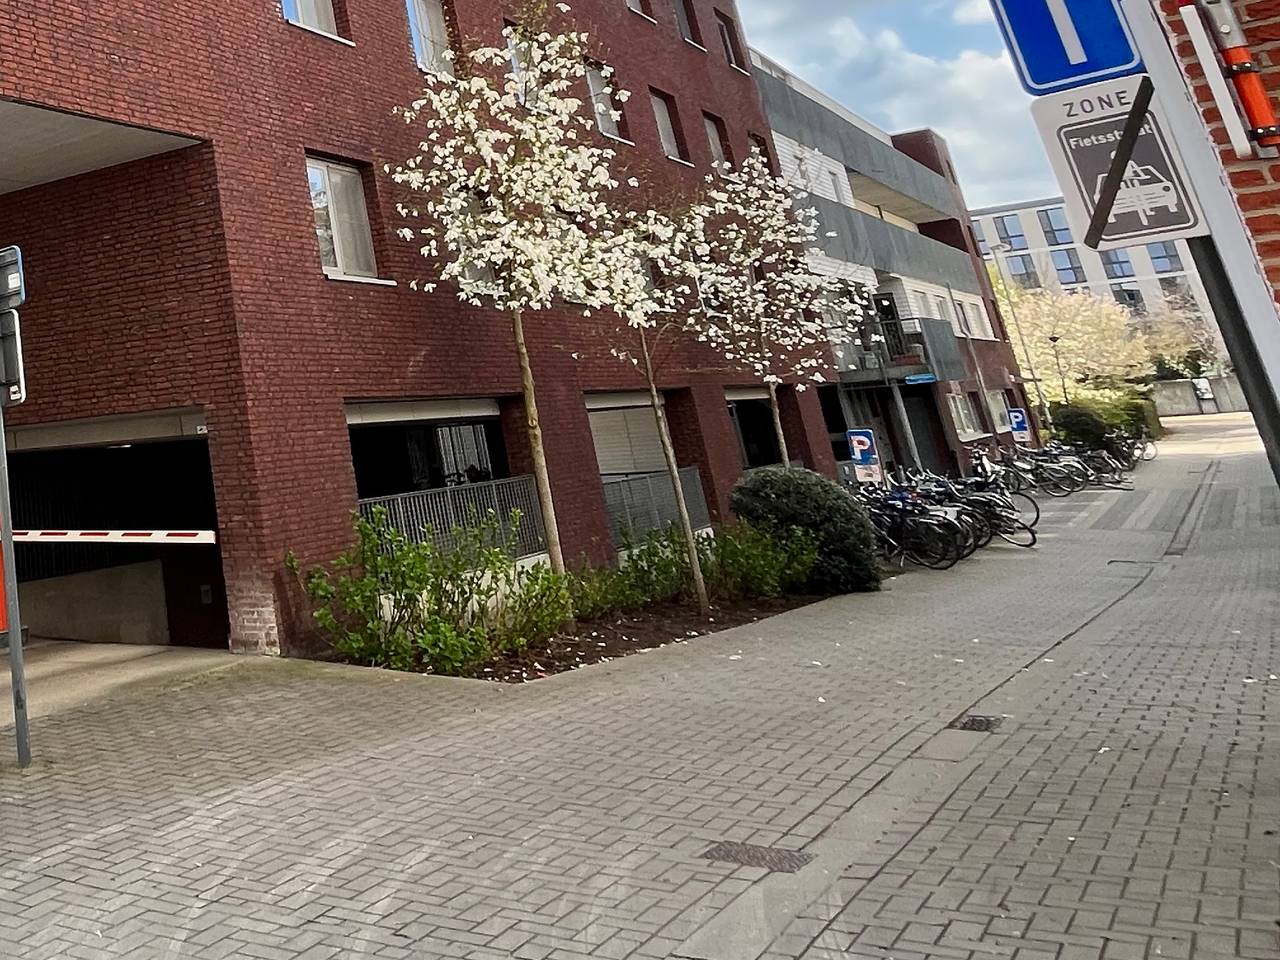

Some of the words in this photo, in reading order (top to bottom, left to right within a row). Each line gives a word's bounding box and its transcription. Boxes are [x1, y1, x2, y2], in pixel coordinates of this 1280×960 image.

[1062, 90, 1132, 118] ZONE
[1068, 123, 1153, 150] Fietsstat
[1010, 412, 1023, 429] P
[850, 435, 871, 460] P
